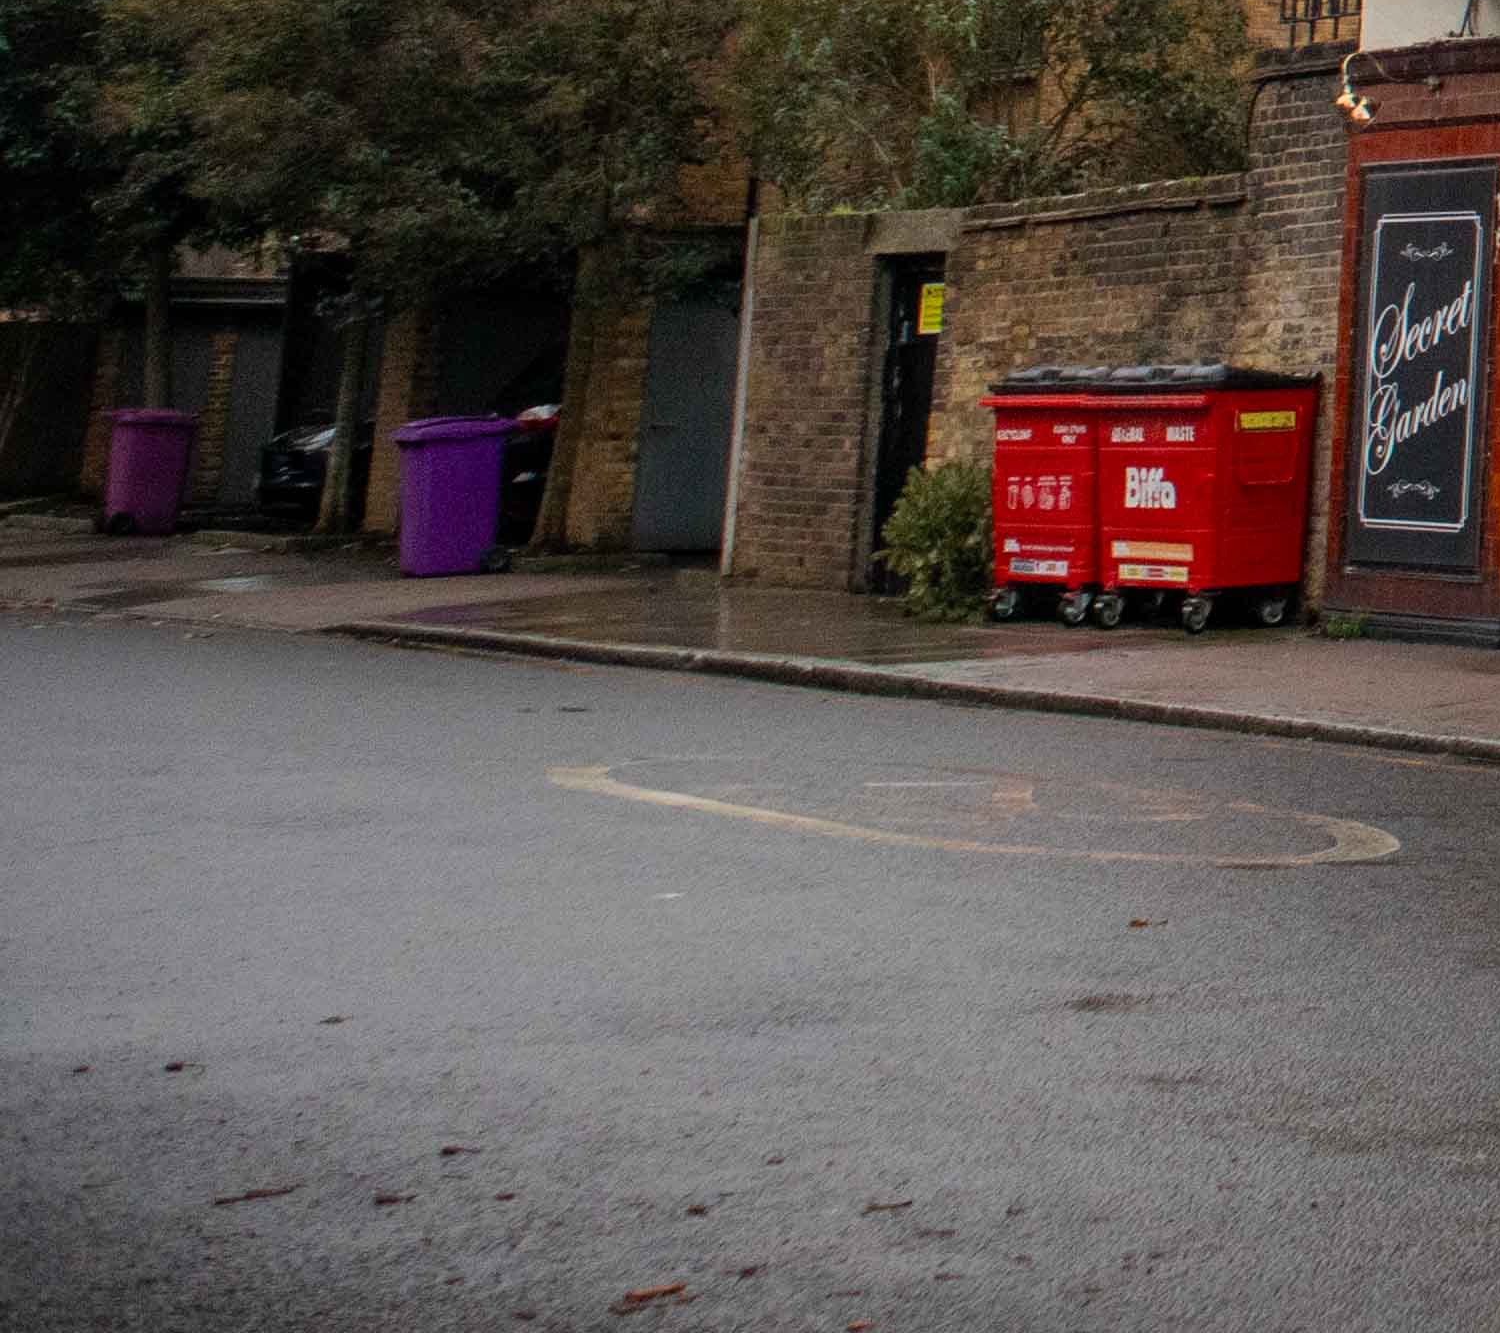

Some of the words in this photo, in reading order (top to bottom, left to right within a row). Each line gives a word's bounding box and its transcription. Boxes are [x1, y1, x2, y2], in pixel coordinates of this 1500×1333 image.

[1370, 281, 1474, 380] Secret
[1364, 369, 1470, 476] Garden
[1124, 466, 1178, 510] Biffa
